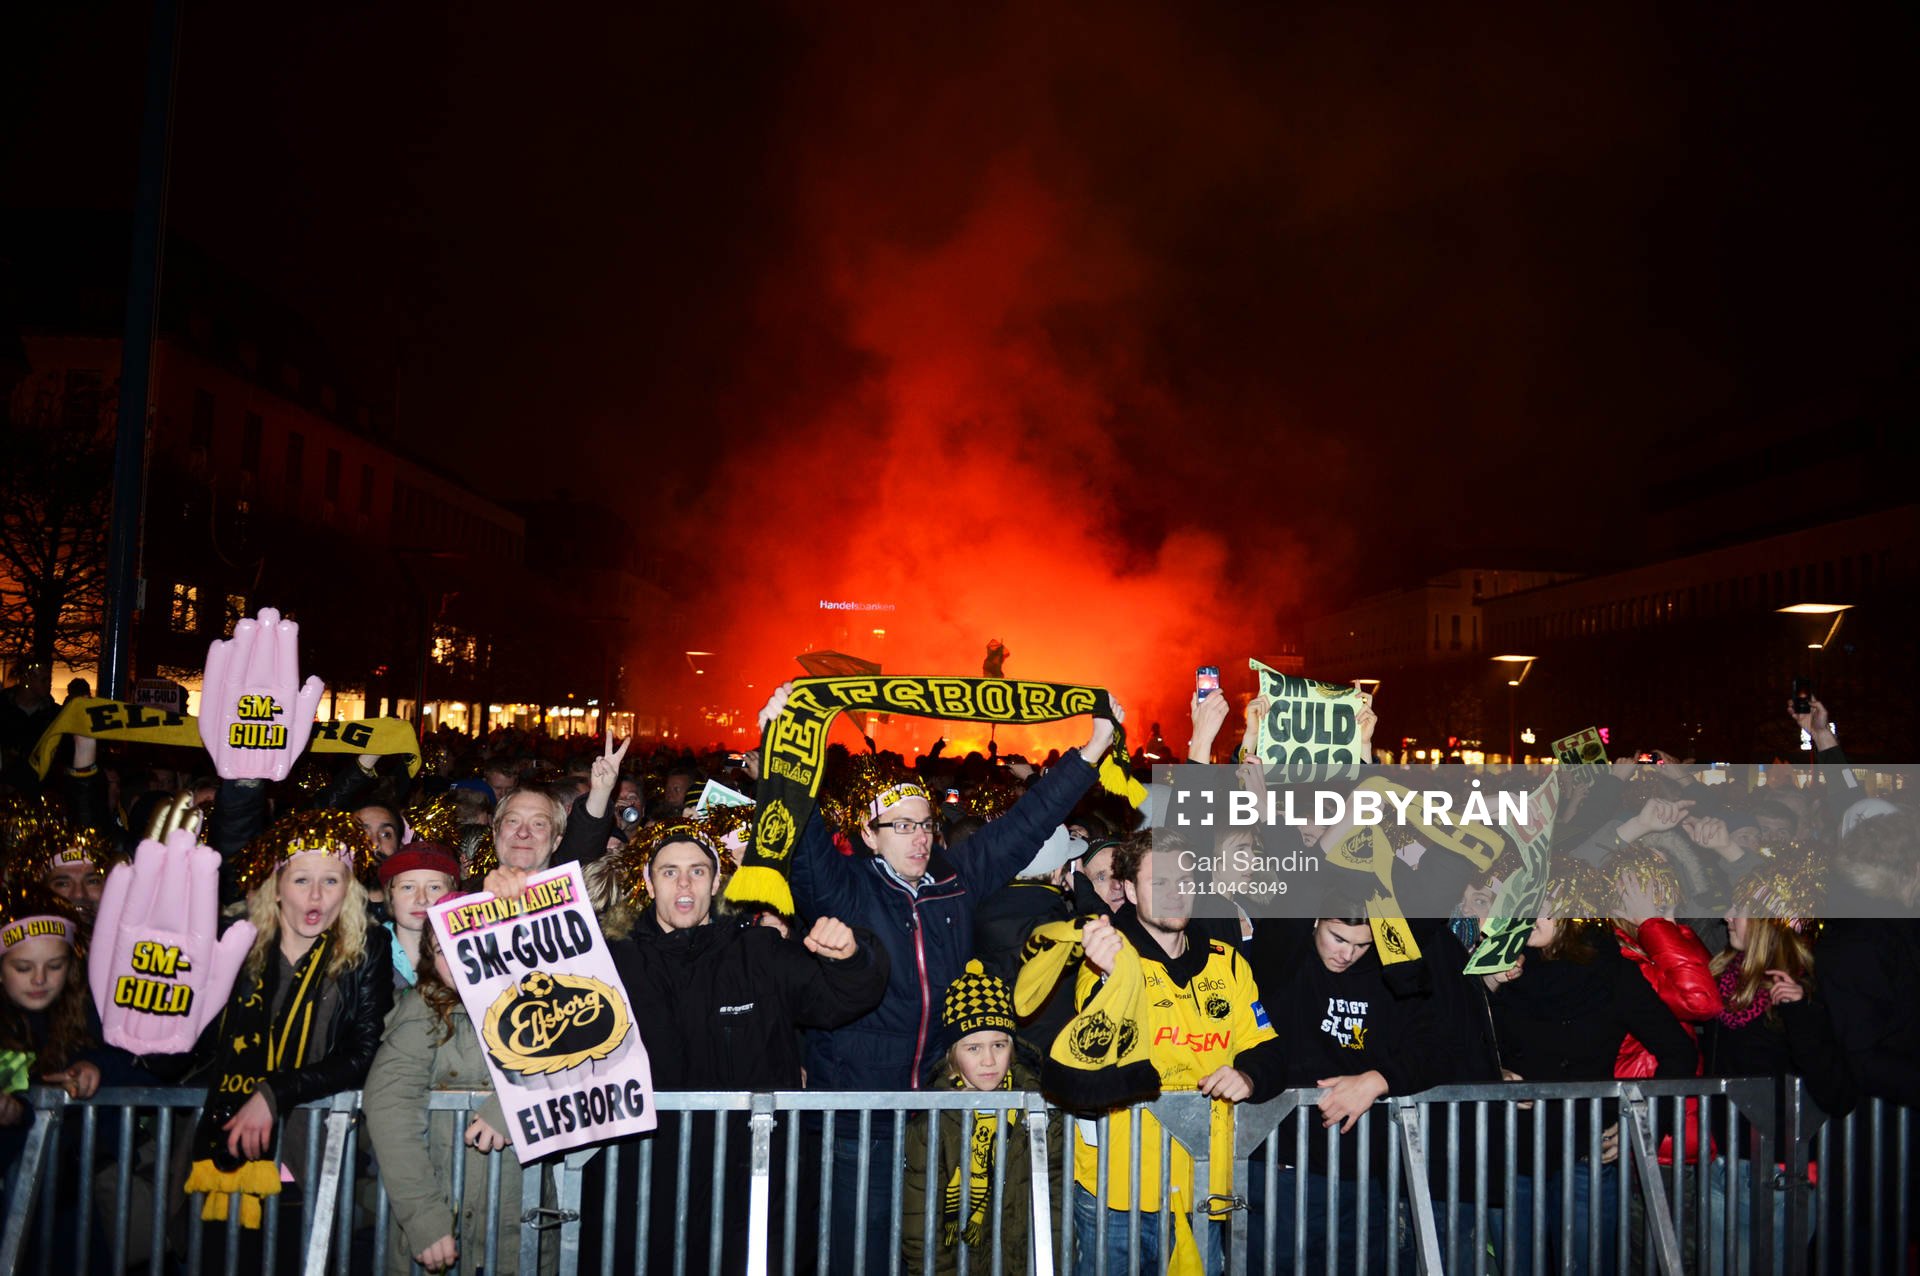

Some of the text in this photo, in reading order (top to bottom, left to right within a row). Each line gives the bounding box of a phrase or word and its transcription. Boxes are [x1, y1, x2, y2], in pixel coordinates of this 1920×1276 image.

[819, 600, 896, 611] Handelsbanken
[235, 694, 283, 721] SM-
[1268, 699, 1356, 745] GULD
[228, 722, 287, 750] GULD
[1264, 744, 1353, 783] 2012
[2, 920, 66, 948] SM-GULD
[457, 909, 593, 985] SM-GULD
[131, 941, 192, 979] SM-
[114, 976, 194, 1017] GULD
[1197, 976, 1226, 992] ellos
[508, 989, 605, 1056] Elfsborg
[960, 1015, 1017, 1033] ELFSBOR
[219, 1073, 268, 1095] 200
[516, 1078, 645, 1147] ELFSBORG
